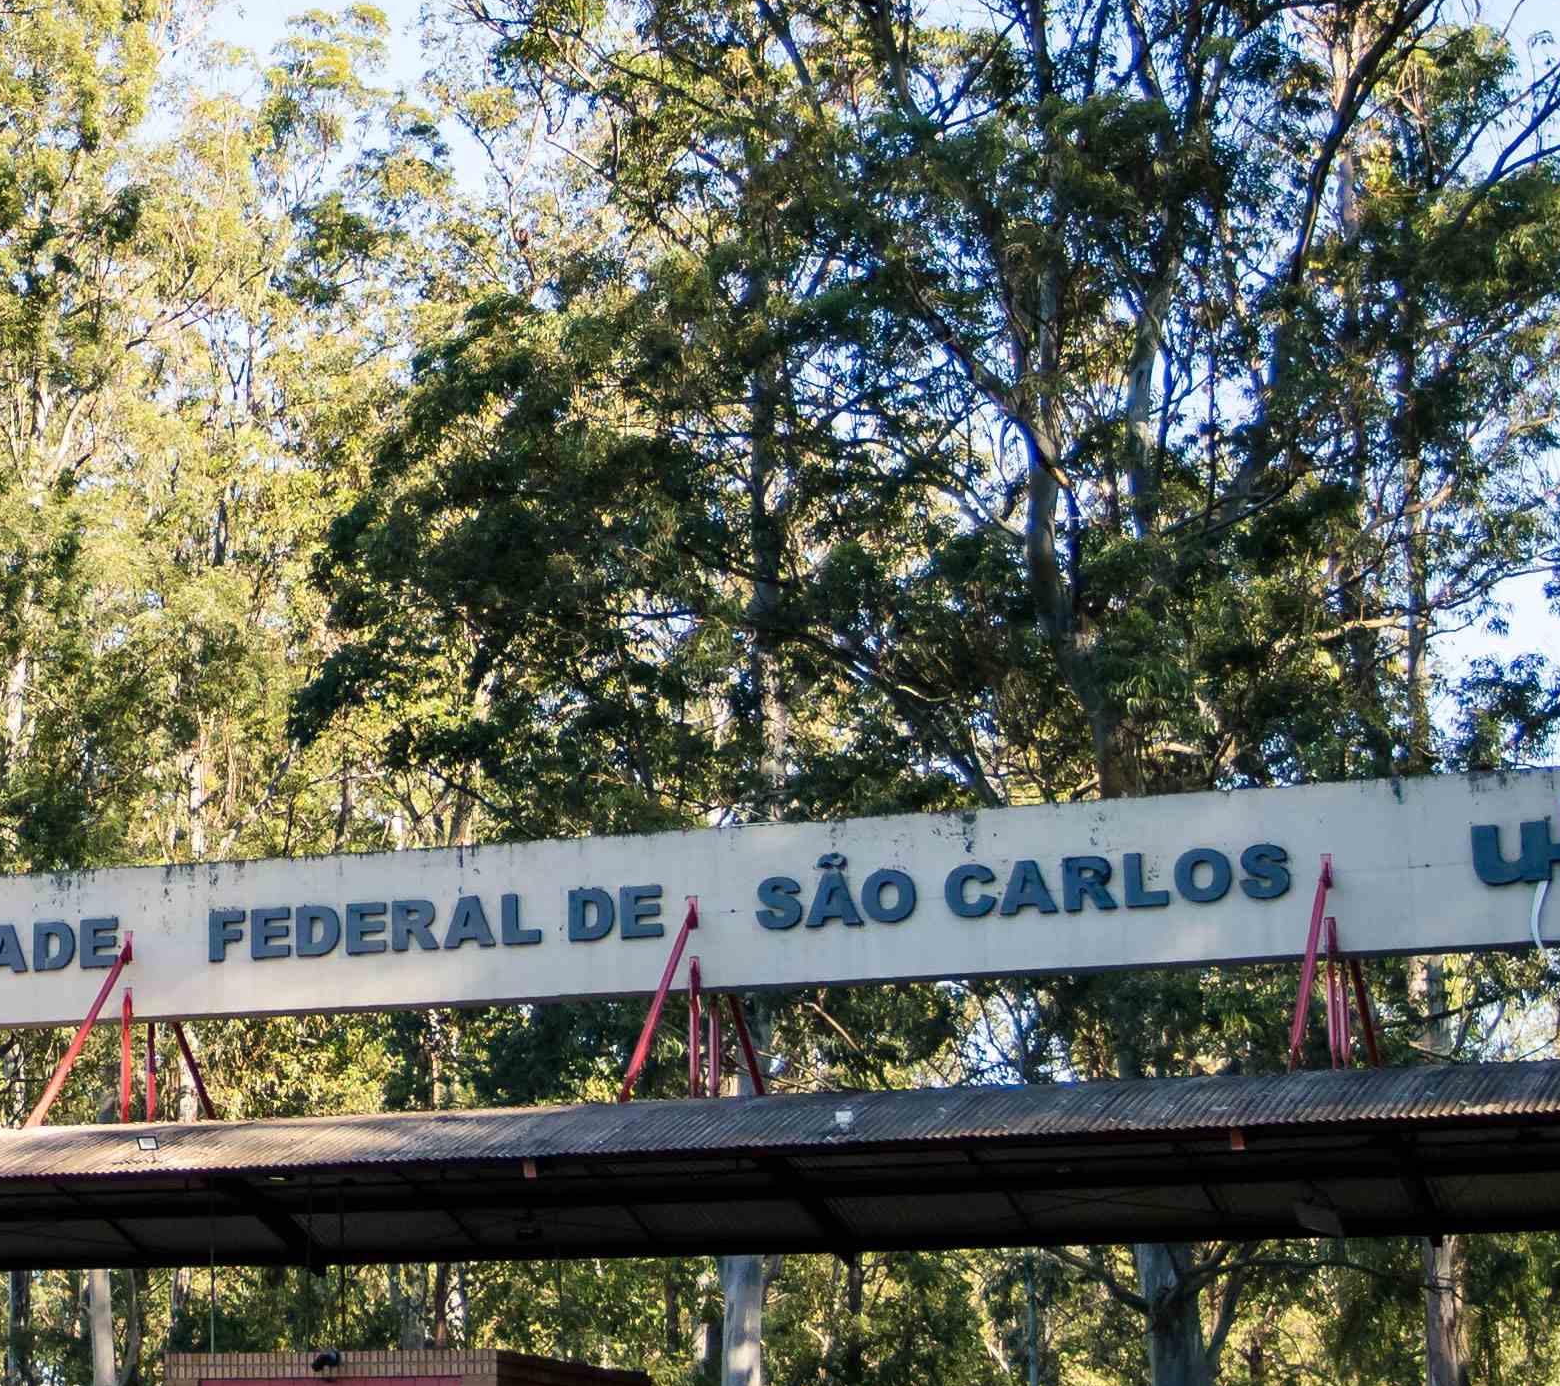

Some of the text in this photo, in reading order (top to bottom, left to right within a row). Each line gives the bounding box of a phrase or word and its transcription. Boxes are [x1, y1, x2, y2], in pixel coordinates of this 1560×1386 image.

[208, 894, 542, 962] FEDERAL
[568, 884, 664, 941] DE
[755, 853, 917, 930] SÃO
[944, 844, 1291, 917] CARLOS
